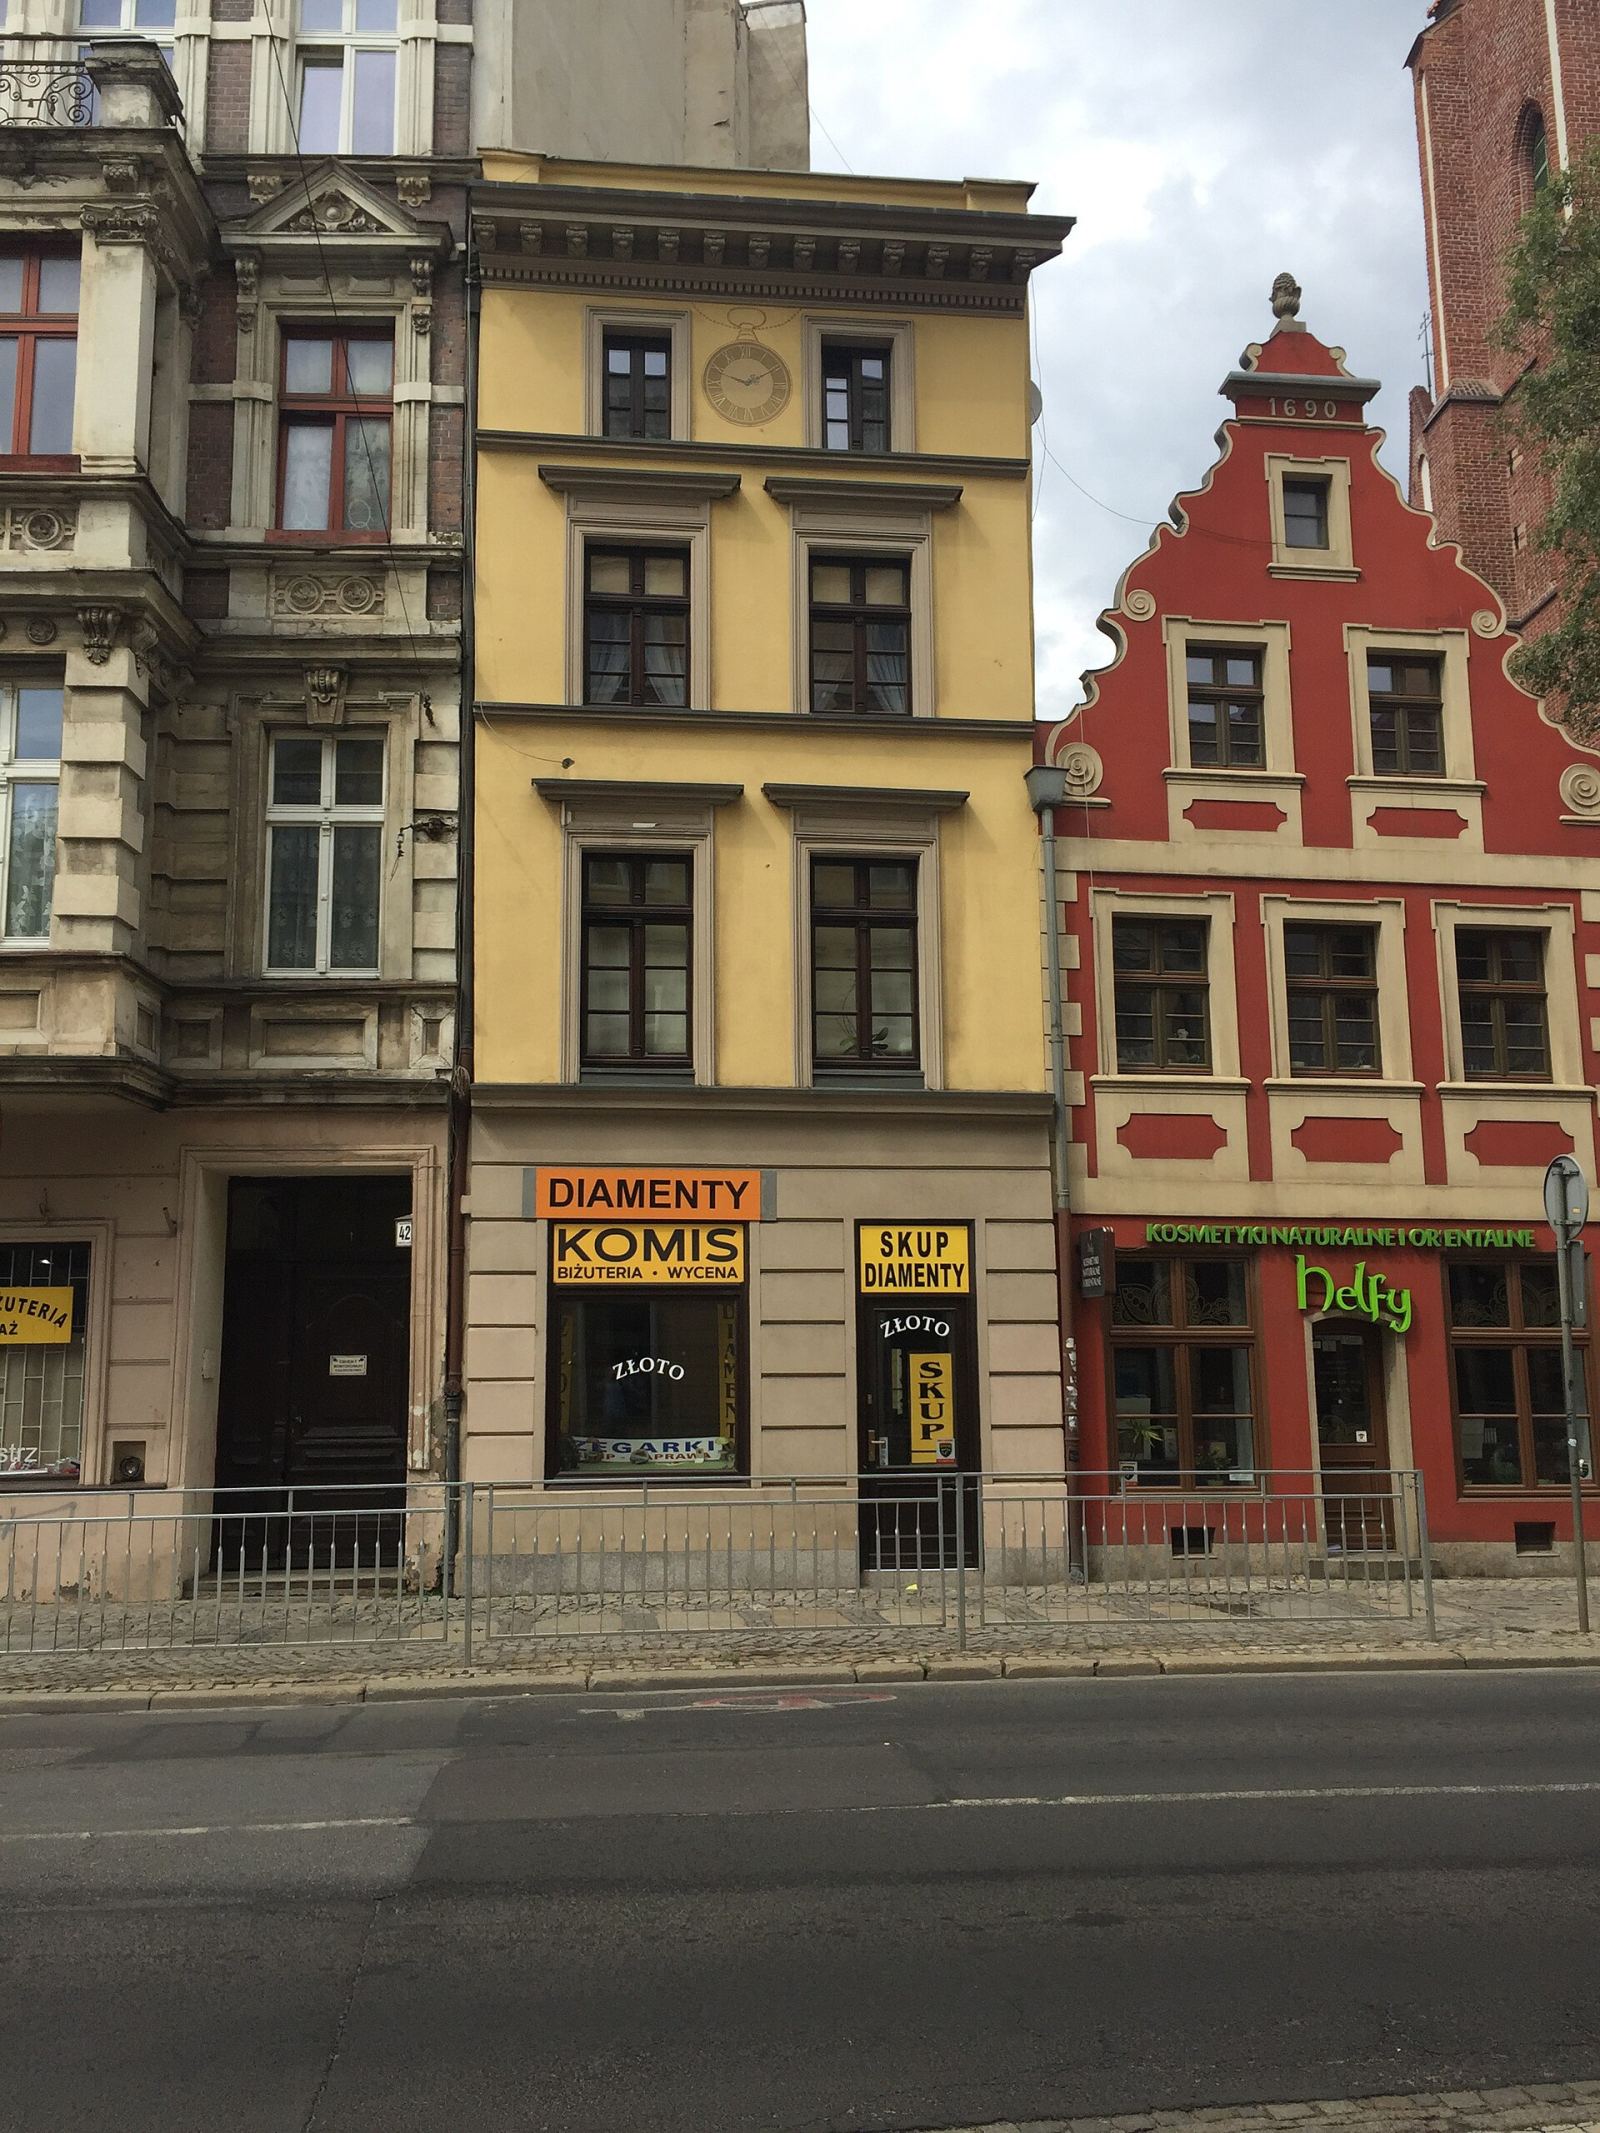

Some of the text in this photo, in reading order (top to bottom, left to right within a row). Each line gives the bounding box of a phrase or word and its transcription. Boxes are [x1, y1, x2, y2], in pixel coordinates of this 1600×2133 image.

[1268, 397, 1337, 418] 1690
[549, 1178, 750, 1210] DIAMENTY
[398, 1224, 411, 1241] 42
[880, 1231, 949, 1258] SKUP
[1146, 1223, 1268, 1244] KOSMETYKI
[1271, 1226, 1396, 1246] NATURALNE
[557, 1227, 739, 1263] KOMIS
[557, 1263, 739, 1279] BIŻUTERIA WYCENA
[864, 1263, 965, 1288] DIAMENTY
[1295, 1254, 1412, 1333] helfy
[880, 1315, 950, 1338] ZŁOTO
[612, 1357, 685, 1381] ZŁOTO
[919, 1361, 945, 1441] SKUP
[576, 1440, 714, 1454] ZEGARKI
